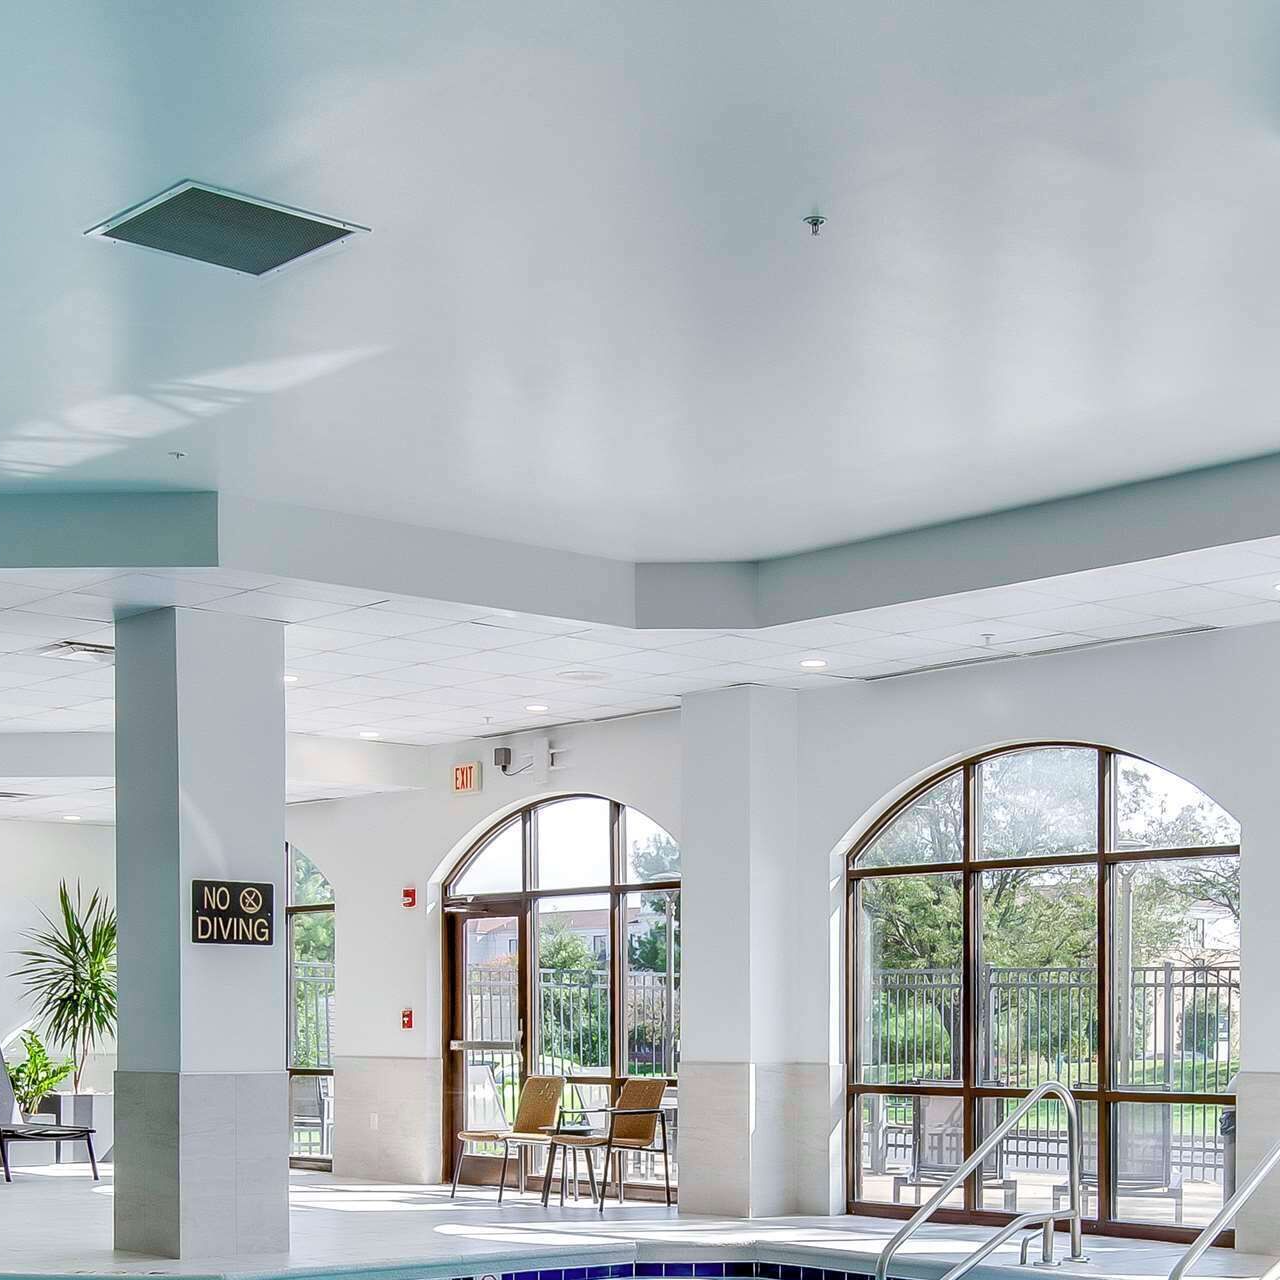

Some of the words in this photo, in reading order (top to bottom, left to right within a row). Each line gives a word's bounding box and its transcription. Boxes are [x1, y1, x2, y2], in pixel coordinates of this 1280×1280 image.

[455, 766, 473, 790] EXIT
[203, 886, 230, 911] NO
[197, 916, 269, 941] DIVING
